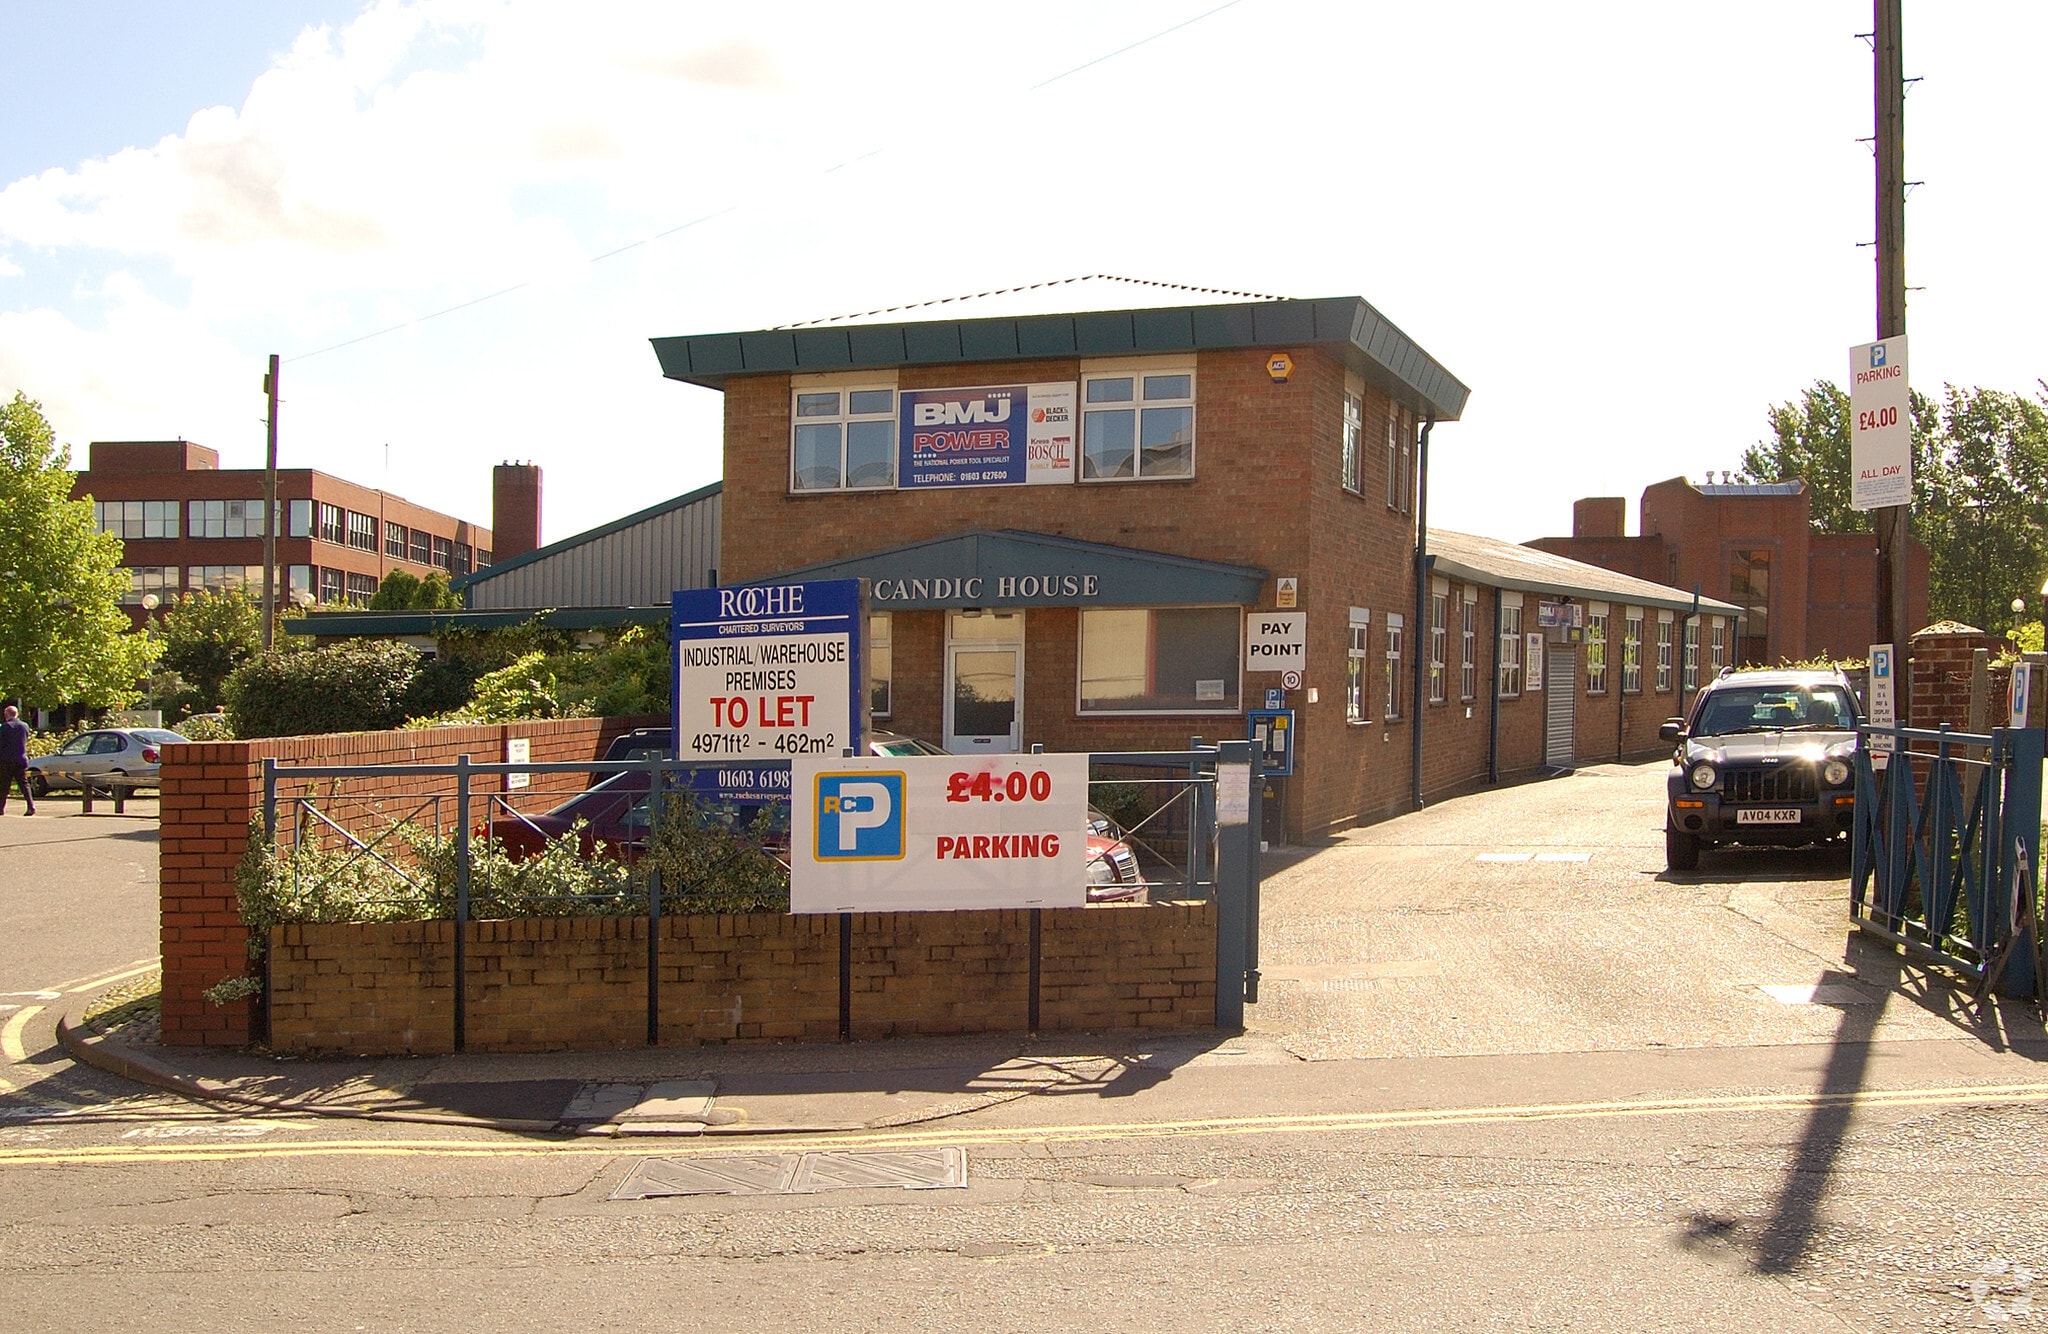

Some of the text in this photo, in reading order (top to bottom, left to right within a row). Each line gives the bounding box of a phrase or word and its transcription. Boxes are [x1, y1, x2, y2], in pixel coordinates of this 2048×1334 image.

[1857, 365, 1901, 384] PARKING
[914, 399, 1011, 426] BMJ
[1859, 406, 1897, 431] £4.00
[913, 429, 1010, 453] POWER
[913, 472, 957, 484] TELEPHONE:
[1860, 464, 1902, 480] ALL DAY
[869, 574, 1099, 601] CANDIC HOUSE
[718, 585, 805, 618] ROCHE
[718, 621, 806, 635] CHARTERED SURVEYORS
[1261, 622, 1292, 635] PAY
[1250, 643, 1303, 657] POINT
[725, 669, 797, 692] PREMISES
[1286, 675, 1296, 685] 10
[709, 695, 815, 729] TO LET
[718, 769, 792, 788] 01603 6198
[946, 770, 1052, 802] £4.00
[1742, 810, 1796, 821] AV04 KXR
[936, 834, 1060, 860] PARKING
